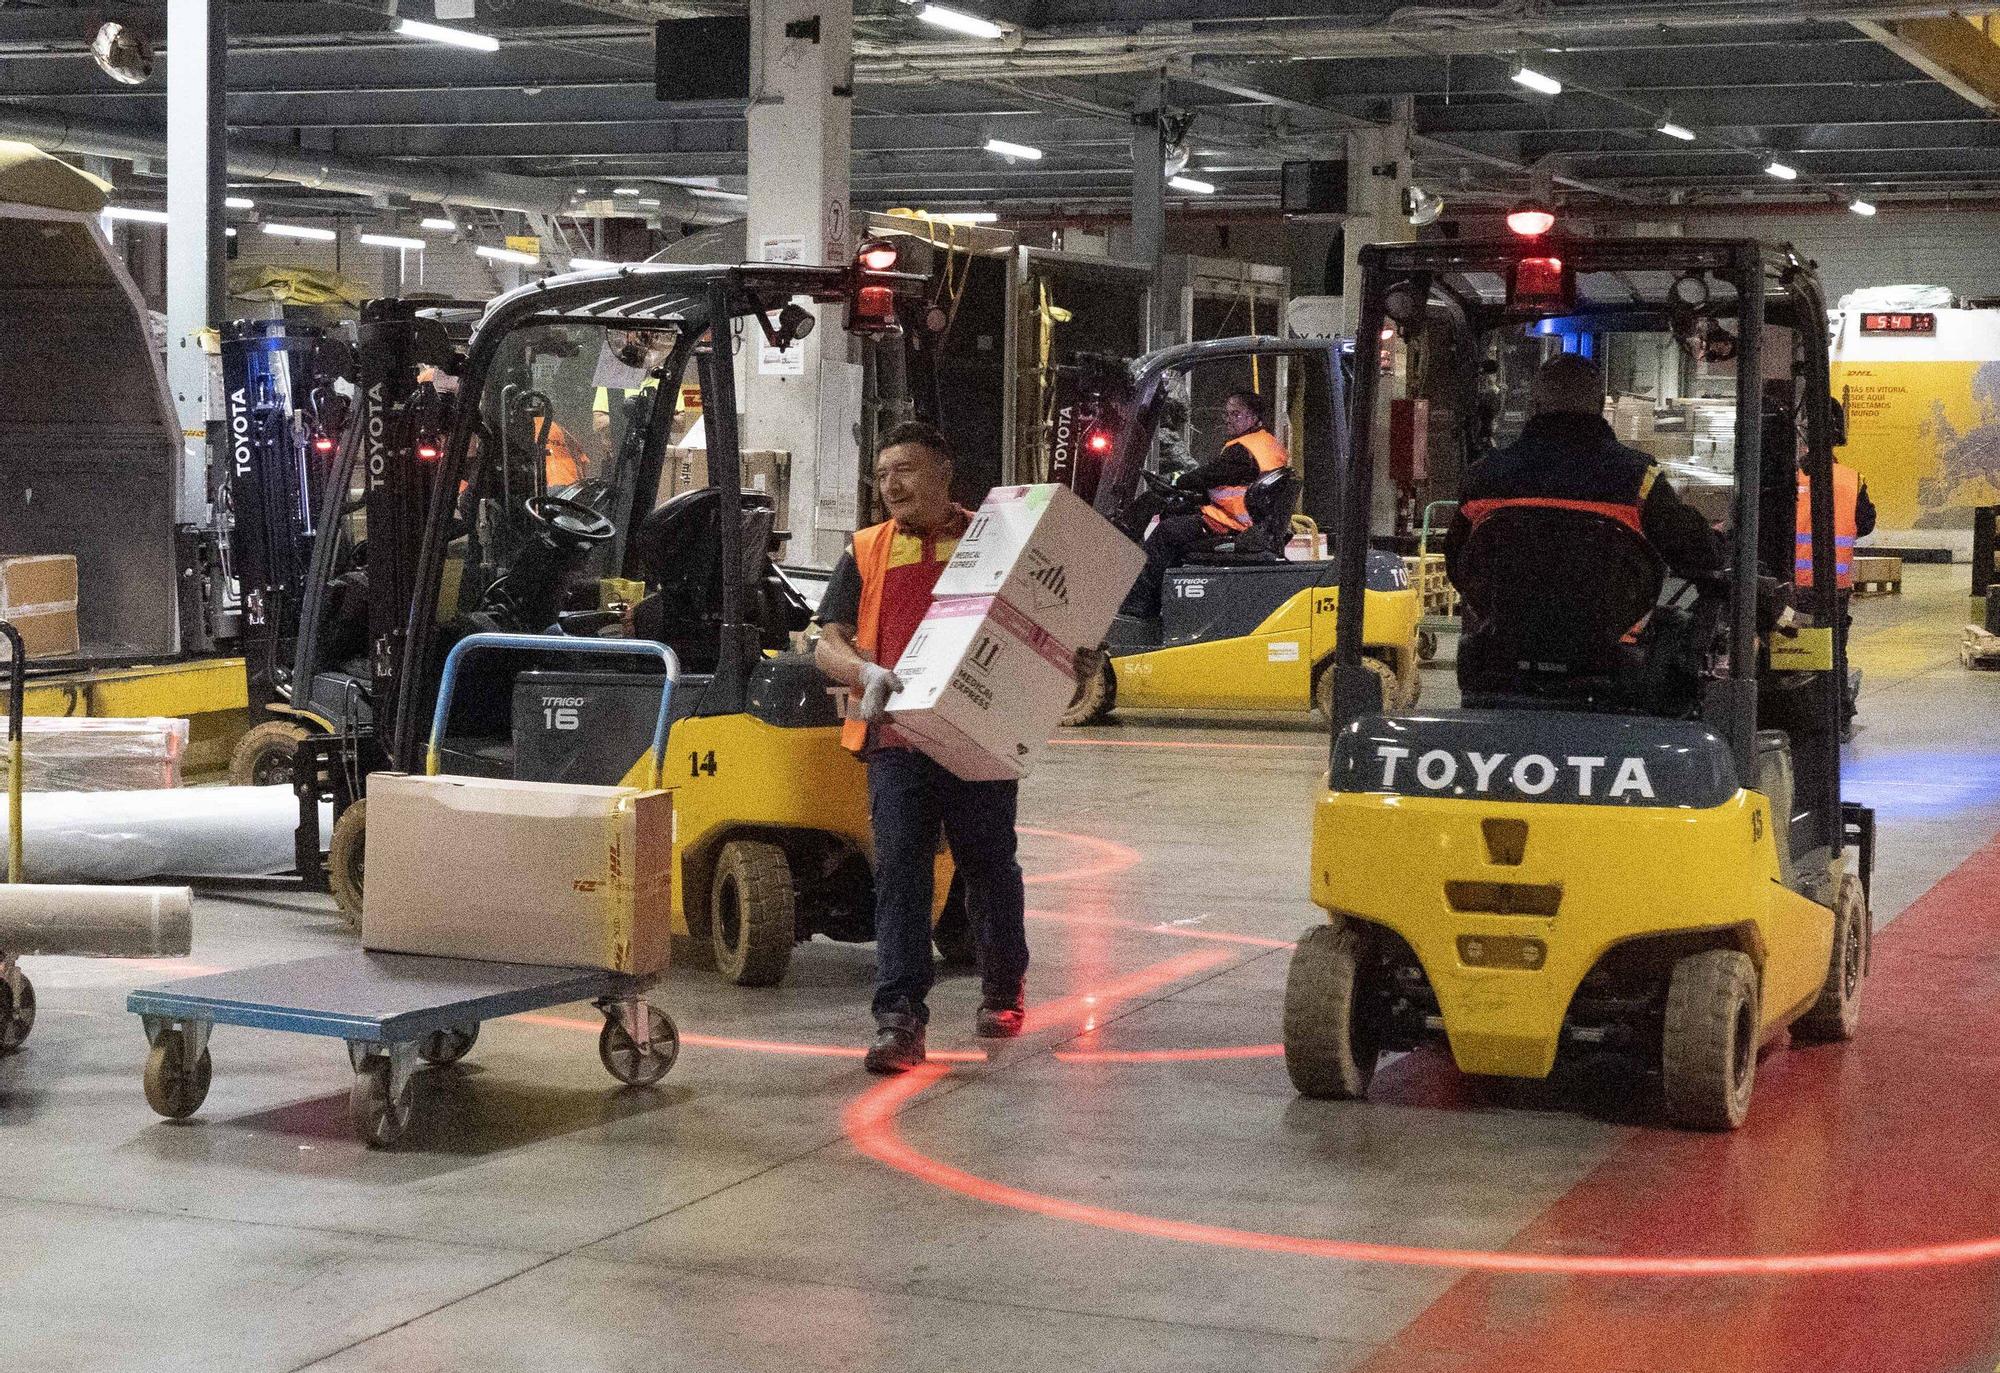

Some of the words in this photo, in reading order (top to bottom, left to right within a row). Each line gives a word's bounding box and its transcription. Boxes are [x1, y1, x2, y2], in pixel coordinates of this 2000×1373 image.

[231, 387, 251, 477] TOYOTA
[368, 382, 385, 491] TOYOTA
[1054, 406, 1073, 471] TOYOTA
[949, 560, 978, 569] EXPRESS
[954, 551, 981, 559] MEDICAL
[1174, 585, 1205, 598] 16
[1314, 597, 1335, 614] 13
[952, 678, 990, 711] EXPRESS
[958, 669, 994, 701] MEDICAL
[543, 708, 579, 730] 16
[688, 750, 717, 777] 14
[1377, 746, 1655, 798] TOYOTA
